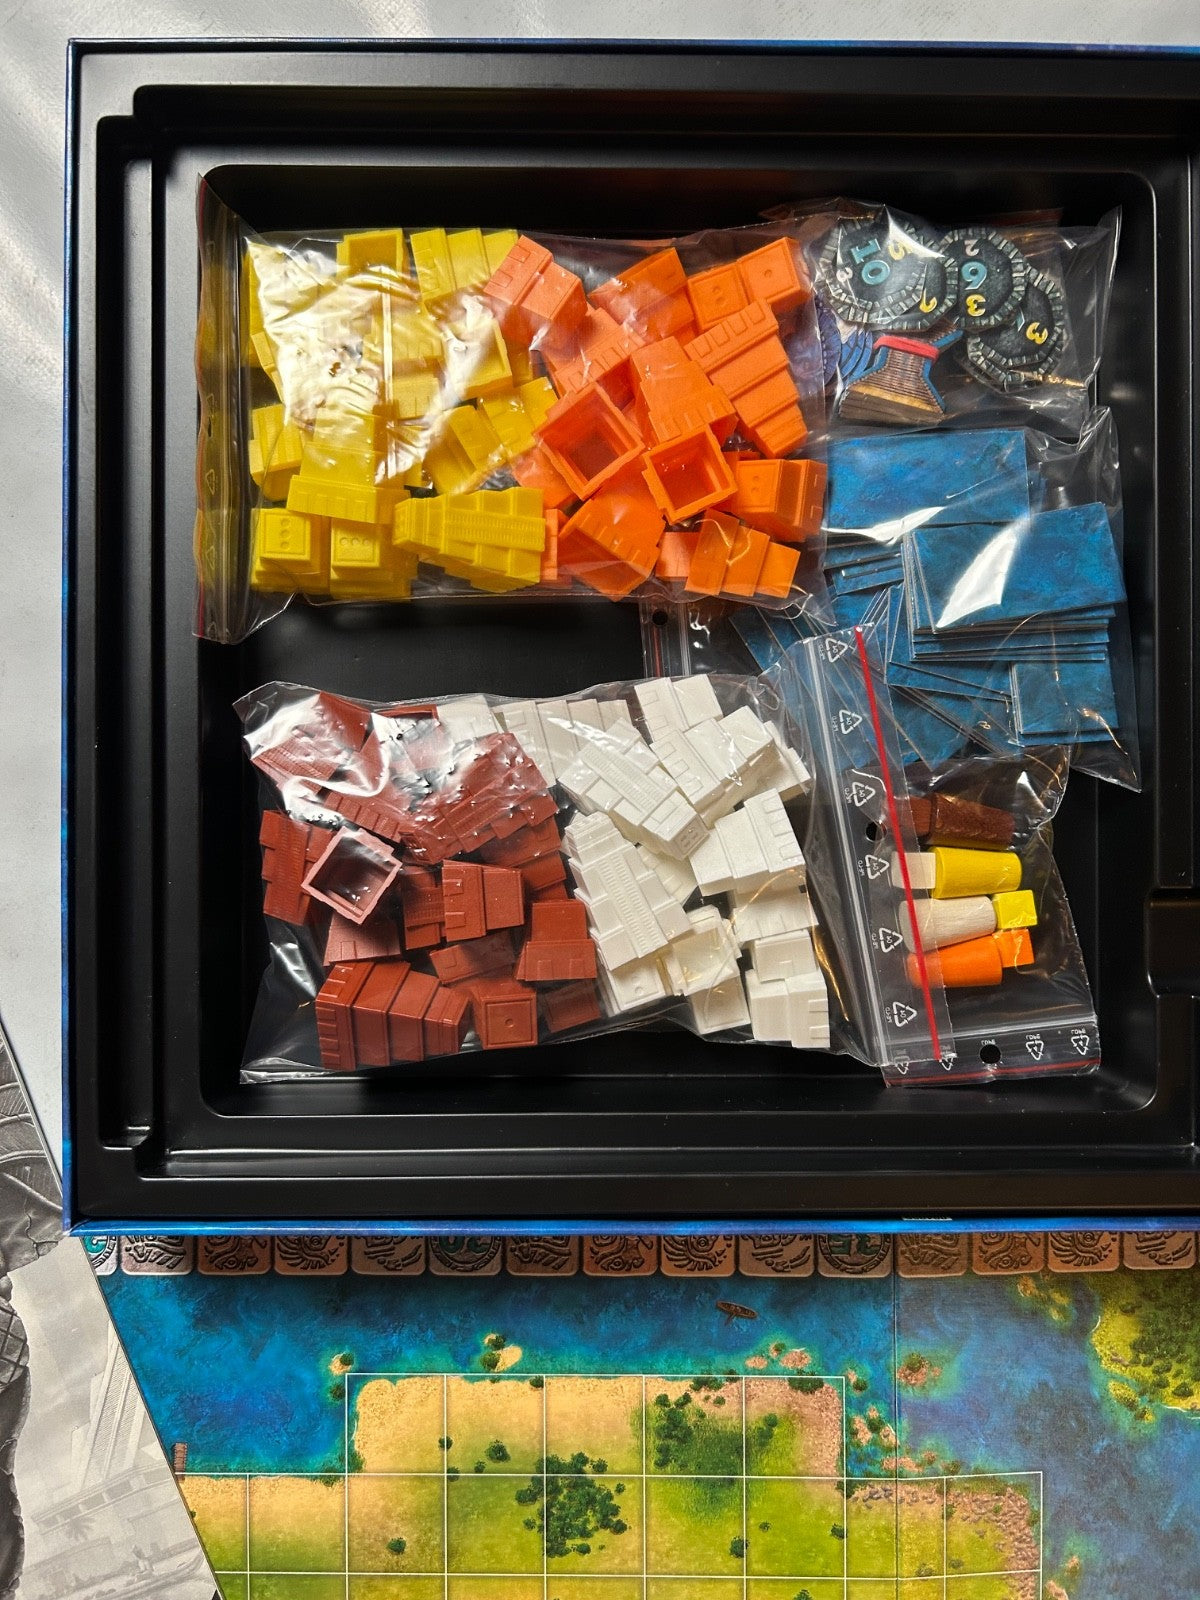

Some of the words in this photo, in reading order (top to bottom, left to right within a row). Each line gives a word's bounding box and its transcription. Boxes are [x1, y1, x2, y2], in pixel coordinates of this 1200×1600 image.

[964, 239, 980, 257] 2
[851, 238, 891, 285] 10
[965, 294, 986, 317] 3
[1026, 322, 1049, 345] 3
